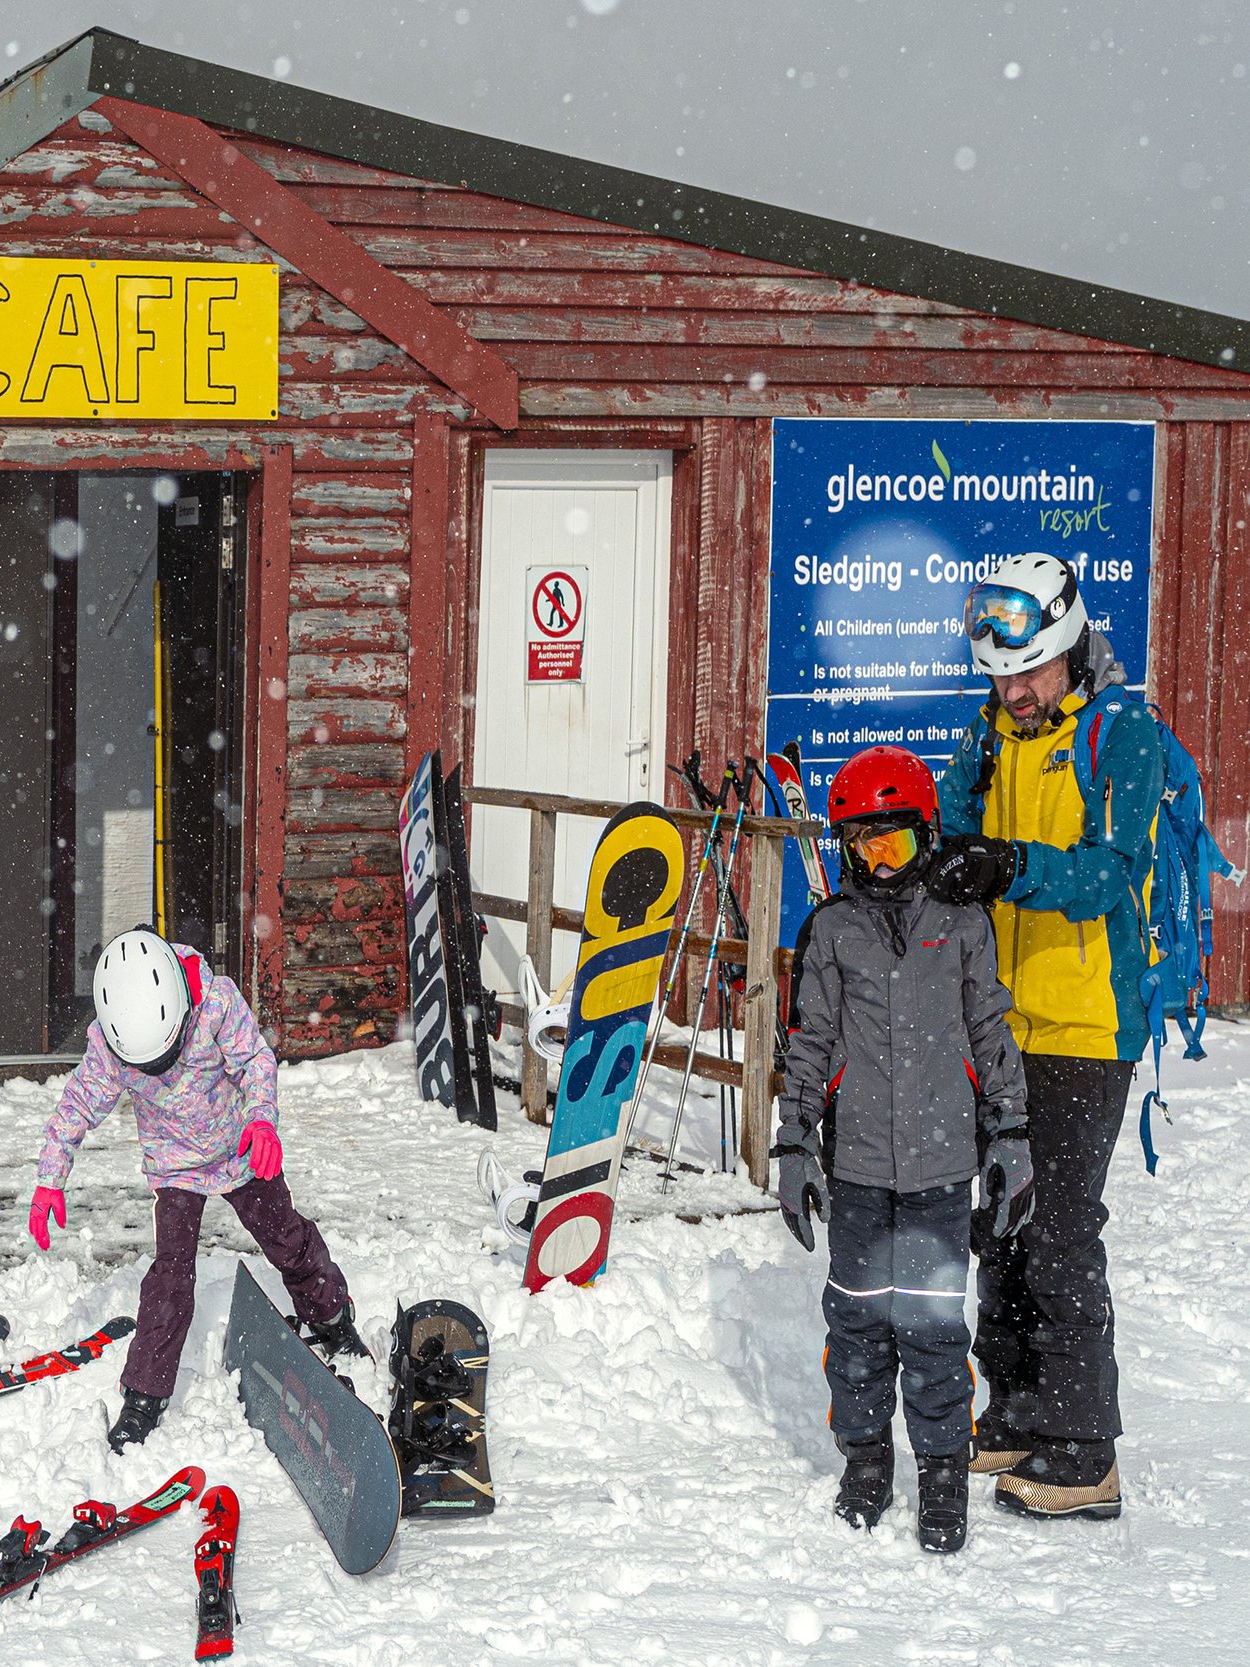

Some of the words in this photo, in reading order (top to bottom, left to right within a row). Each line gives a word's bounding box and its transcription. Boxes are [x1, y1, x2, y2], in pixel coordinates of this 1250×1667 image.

[828, 464, 945, 512] glencoe
[954, 465, 1094, 501] mountain
[1040, 485, 1111, 538] resort
[794, 554, 902, 592] Sledging
[1093, 559, 1133, 582] use
[815, 620, 832, 636] All
[837, 619, 892, 635] Children
[896, 618, 938, 638] (under
[542, 643, 580, 651] admittance
[539, 660, 572, 668] personnel
[548, 668, 563, 677] only
[815, 664, 825, 679] Is
[830, 664, 850, 678] not
[855, 662, 906, 678] suitable
[910, 662, 929, 677] for
[932, 661, 968, 676] those
[813, 730, 823, 744] Is
[828, 729, 849, 743] not
[853, 727, 903, 742] allowed
[907, 730, 924, 741] on
[927, 727, 947, 740] the
